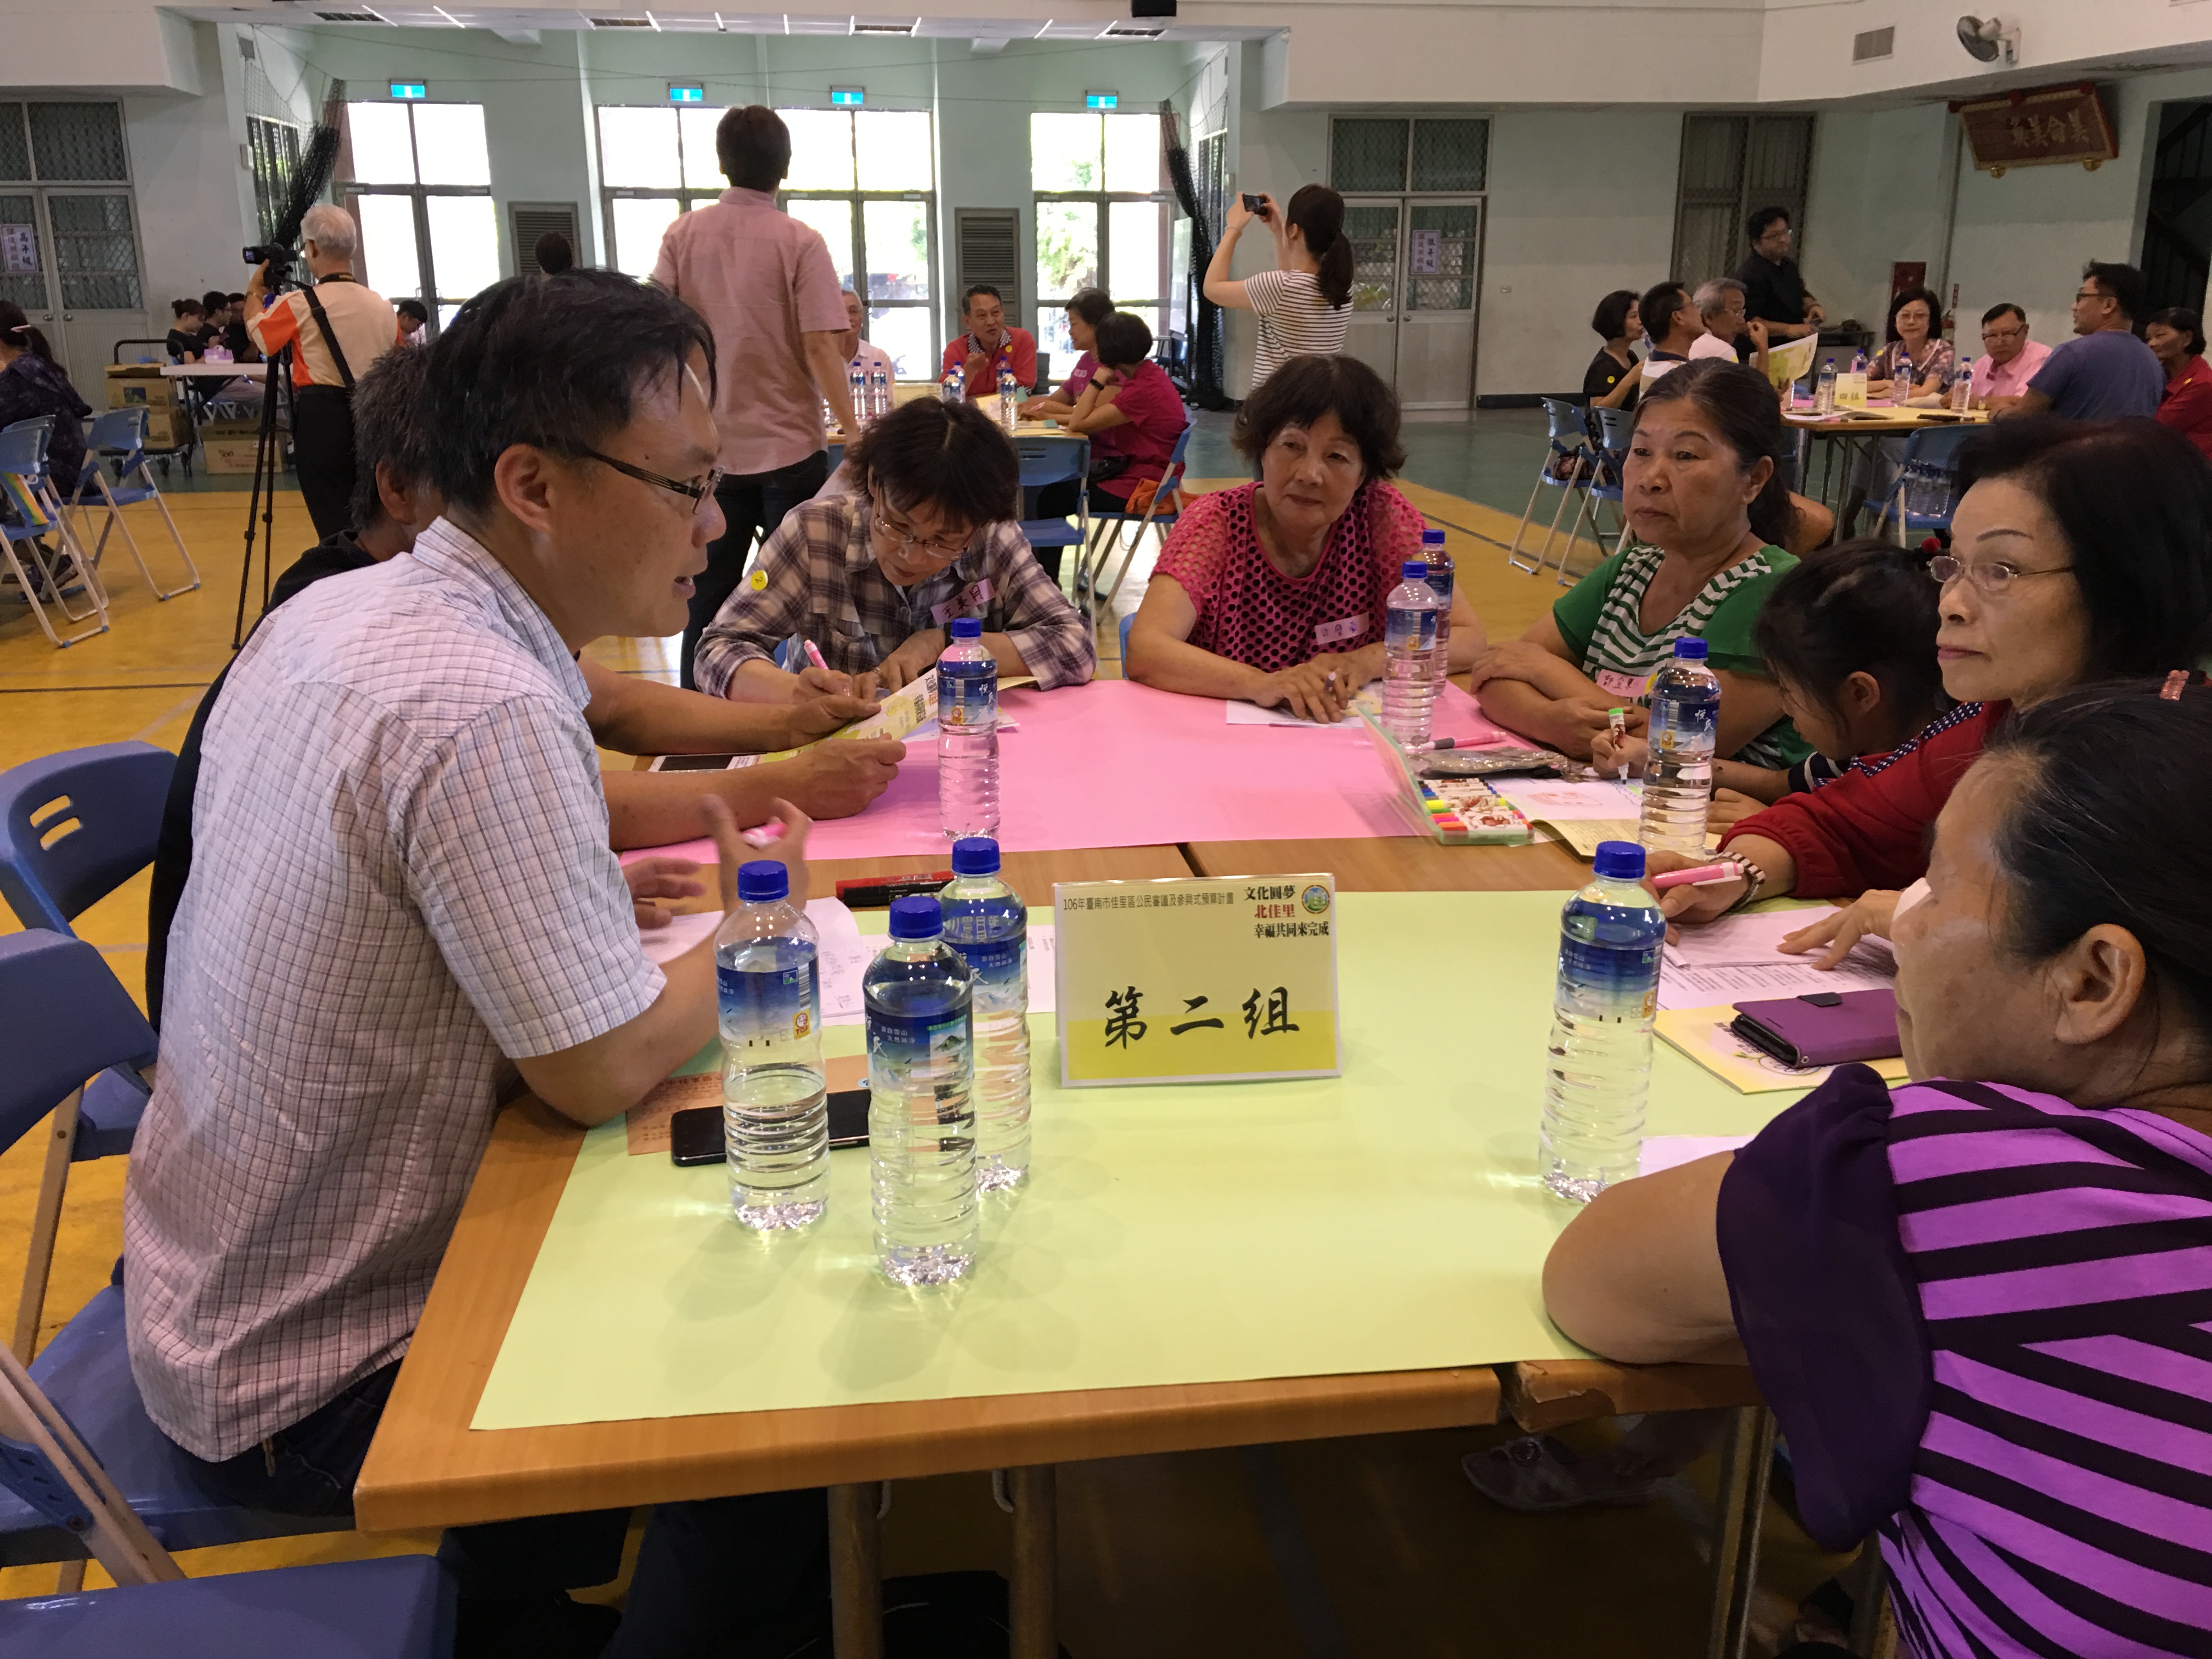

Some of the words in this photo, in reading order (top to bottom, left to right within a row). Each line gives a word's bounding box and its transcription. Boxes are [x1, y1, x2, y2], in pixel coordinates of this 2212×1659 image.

[754, 576, 763, 584] 2
[1243, 884, 1296, 901] 文化圓夢
[1254, 904, 1296, 919] 北佳里
[1254, 921, 1330, 939] 幸福共同來完成
[1104, 985, 1300, 1049] 第二組
